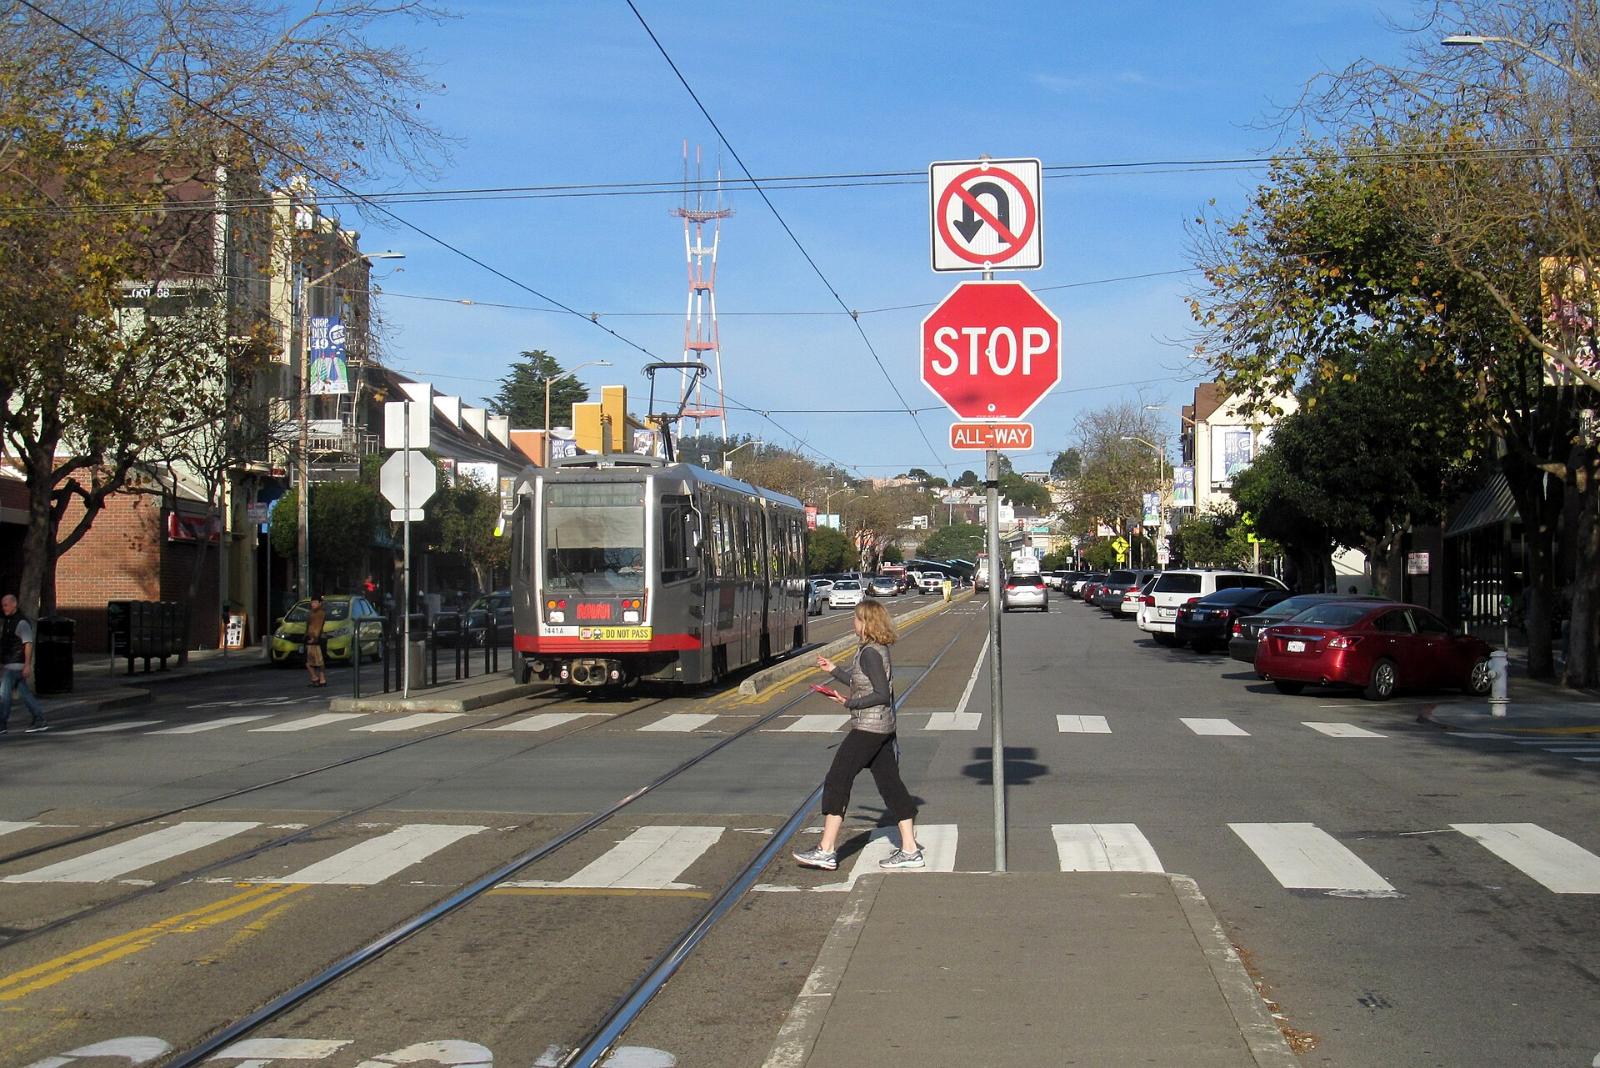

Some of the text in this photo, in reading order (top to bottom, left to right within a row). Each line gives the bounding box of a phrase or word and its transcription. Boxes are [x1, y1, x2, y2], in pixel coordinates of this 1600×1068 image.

[931, 326, 1051, 376] STOP
[954, 428, 1029, 444] ALL-WAY
[605, 629, 649, 639] DO NOT PASS
